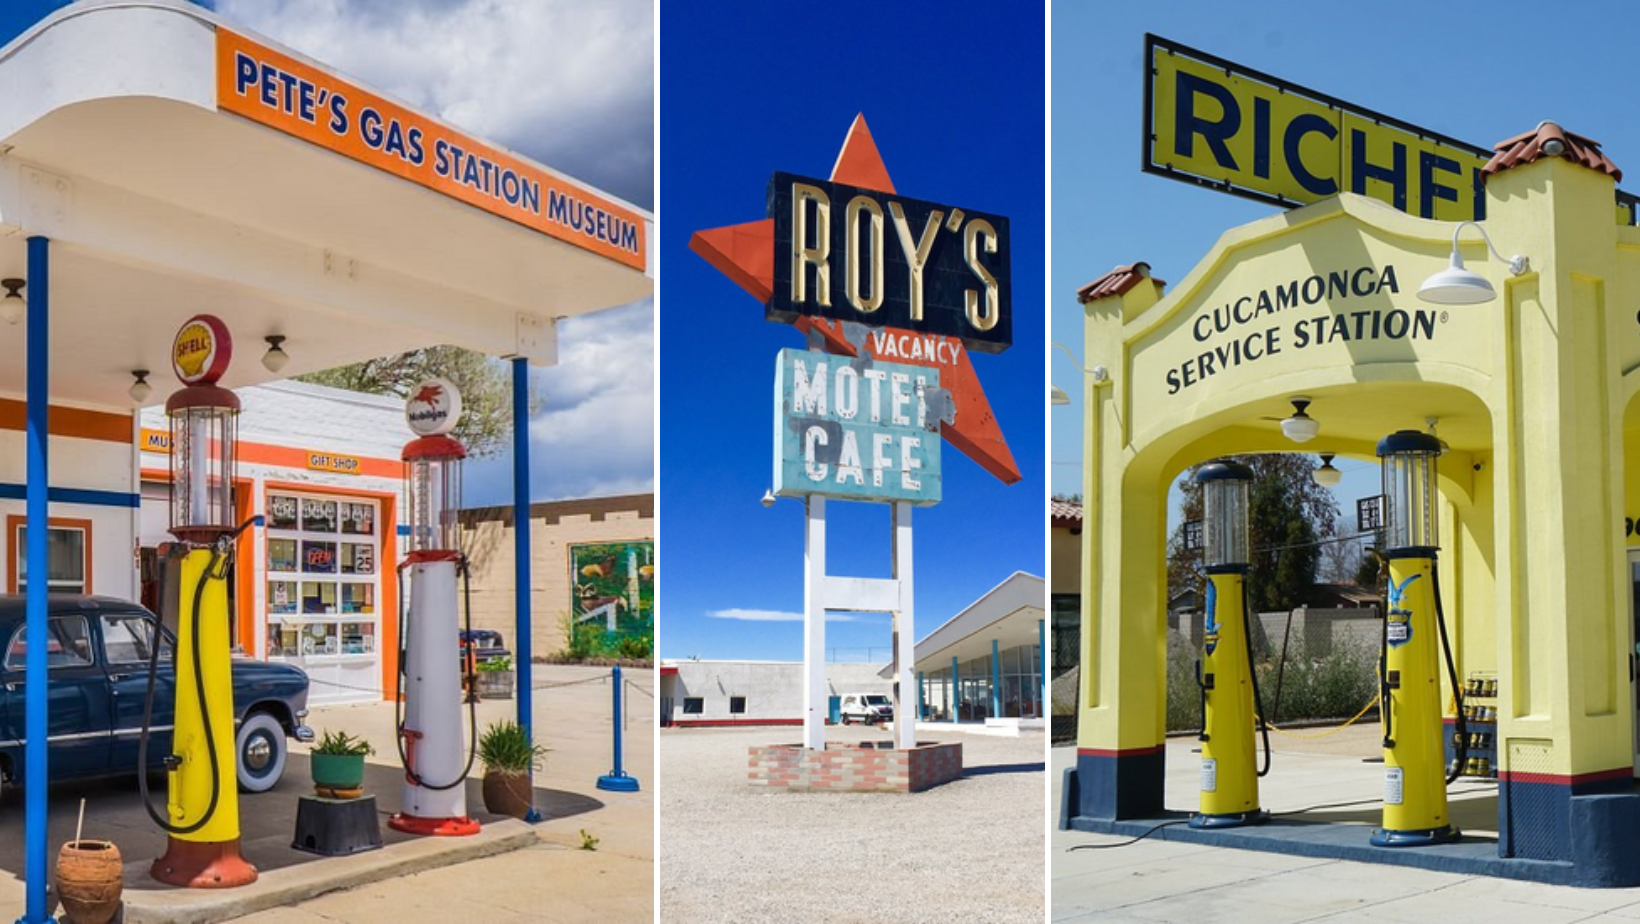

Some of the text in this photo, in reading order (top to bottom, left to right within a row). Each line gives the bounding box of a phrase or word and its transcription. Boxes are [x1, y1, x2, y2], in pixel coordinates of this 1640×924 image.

[236, 52, 639, 254] PETE'S GAS STATION MUSEUM
[791, 181, 999, 332] ROY'S
[1193, 264, 1400, 343] CUCAMONGA
[177, 336, 208, 358] SHELL
[872, 330, 963, 366] VACANCY
[1165, 326, 1282, 396] SERVICE
[310, 454, 358, 470] GIFT SHOP
[804, 424, 922, 491] CAFE
[356, 556, 373, 572] 25
